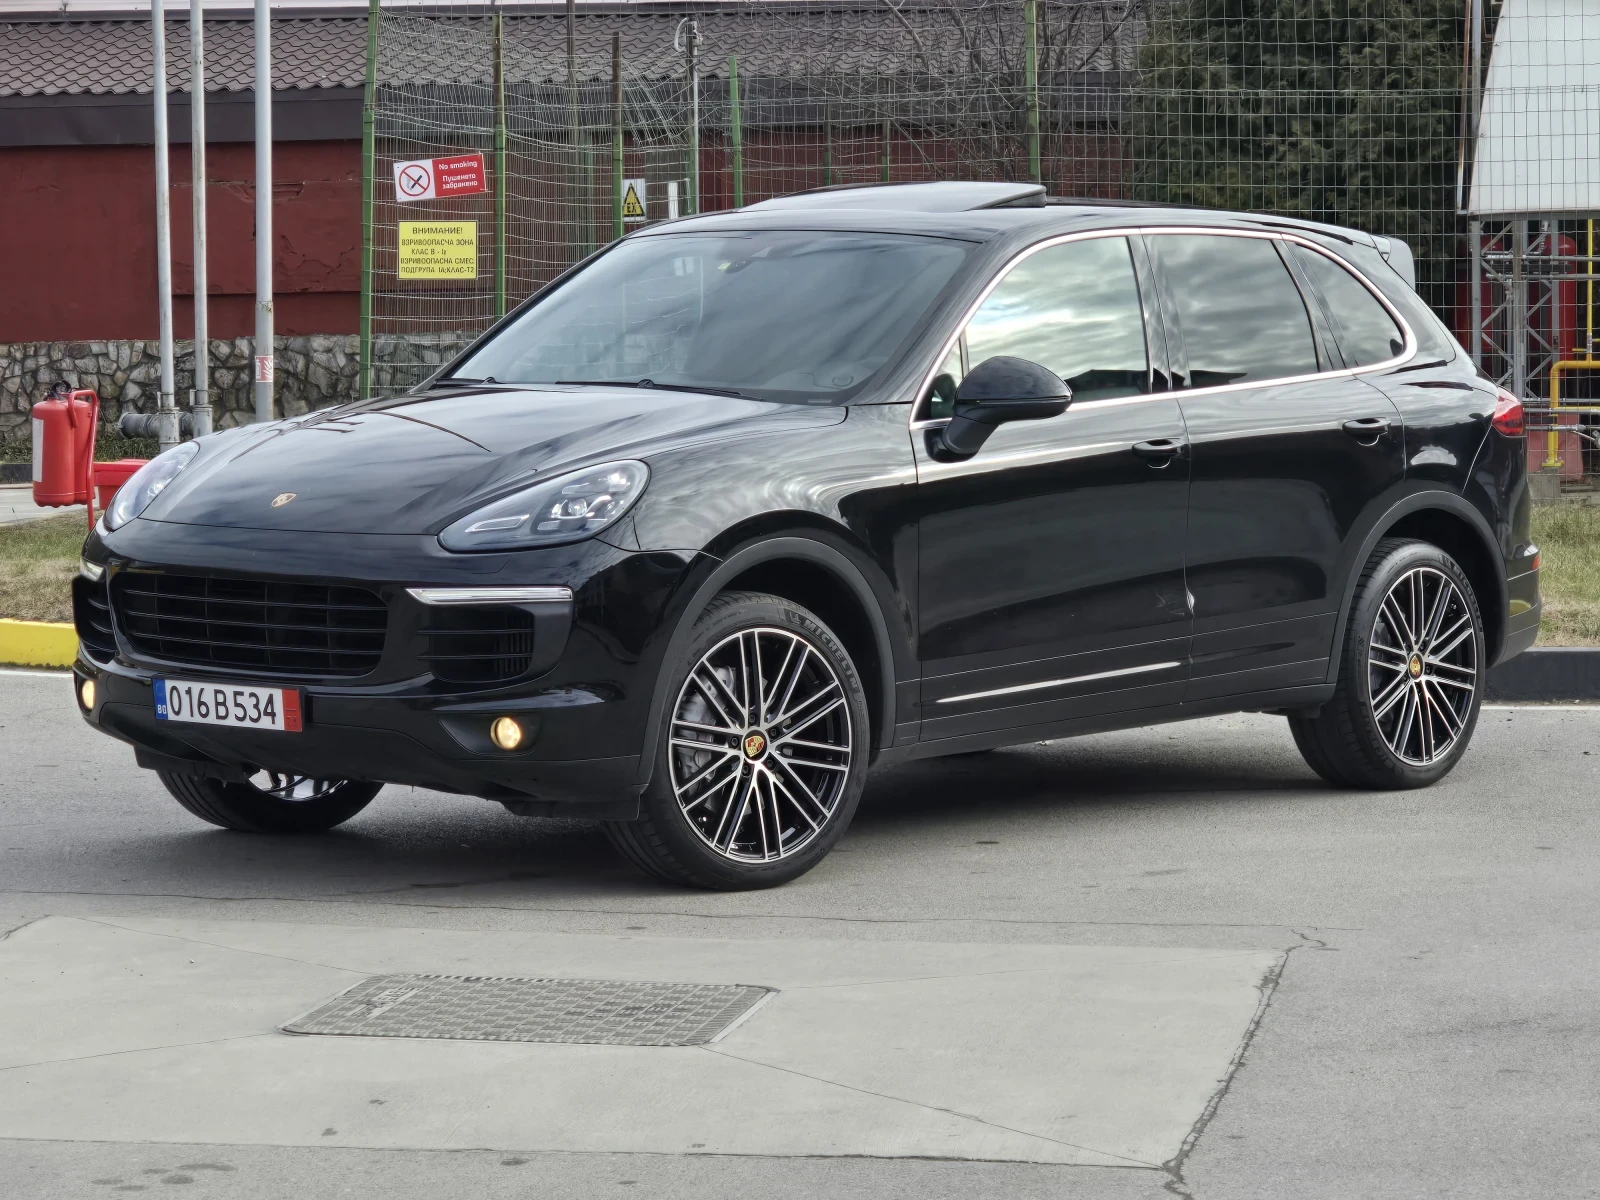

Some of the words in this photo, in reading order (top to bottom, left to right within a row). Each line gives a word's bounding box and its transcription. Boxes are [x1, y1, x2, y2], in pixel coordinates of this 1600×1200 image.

[450, 160, 478, 169] smoking
[442, 173, 476, 182] Пушенето
[442, 180, 478, 190] забранено
[412, 227, 463, 235] ВНИМАНИЕ!
[455, 238, 474, 246] ЗОНА
[400, 266, 435, 274] ПОДГРУПА
[803, 619, 860, 689] MICHELIN
[157, 704, 167, 715] BG
[169, 685, 276, 725] 016B534
